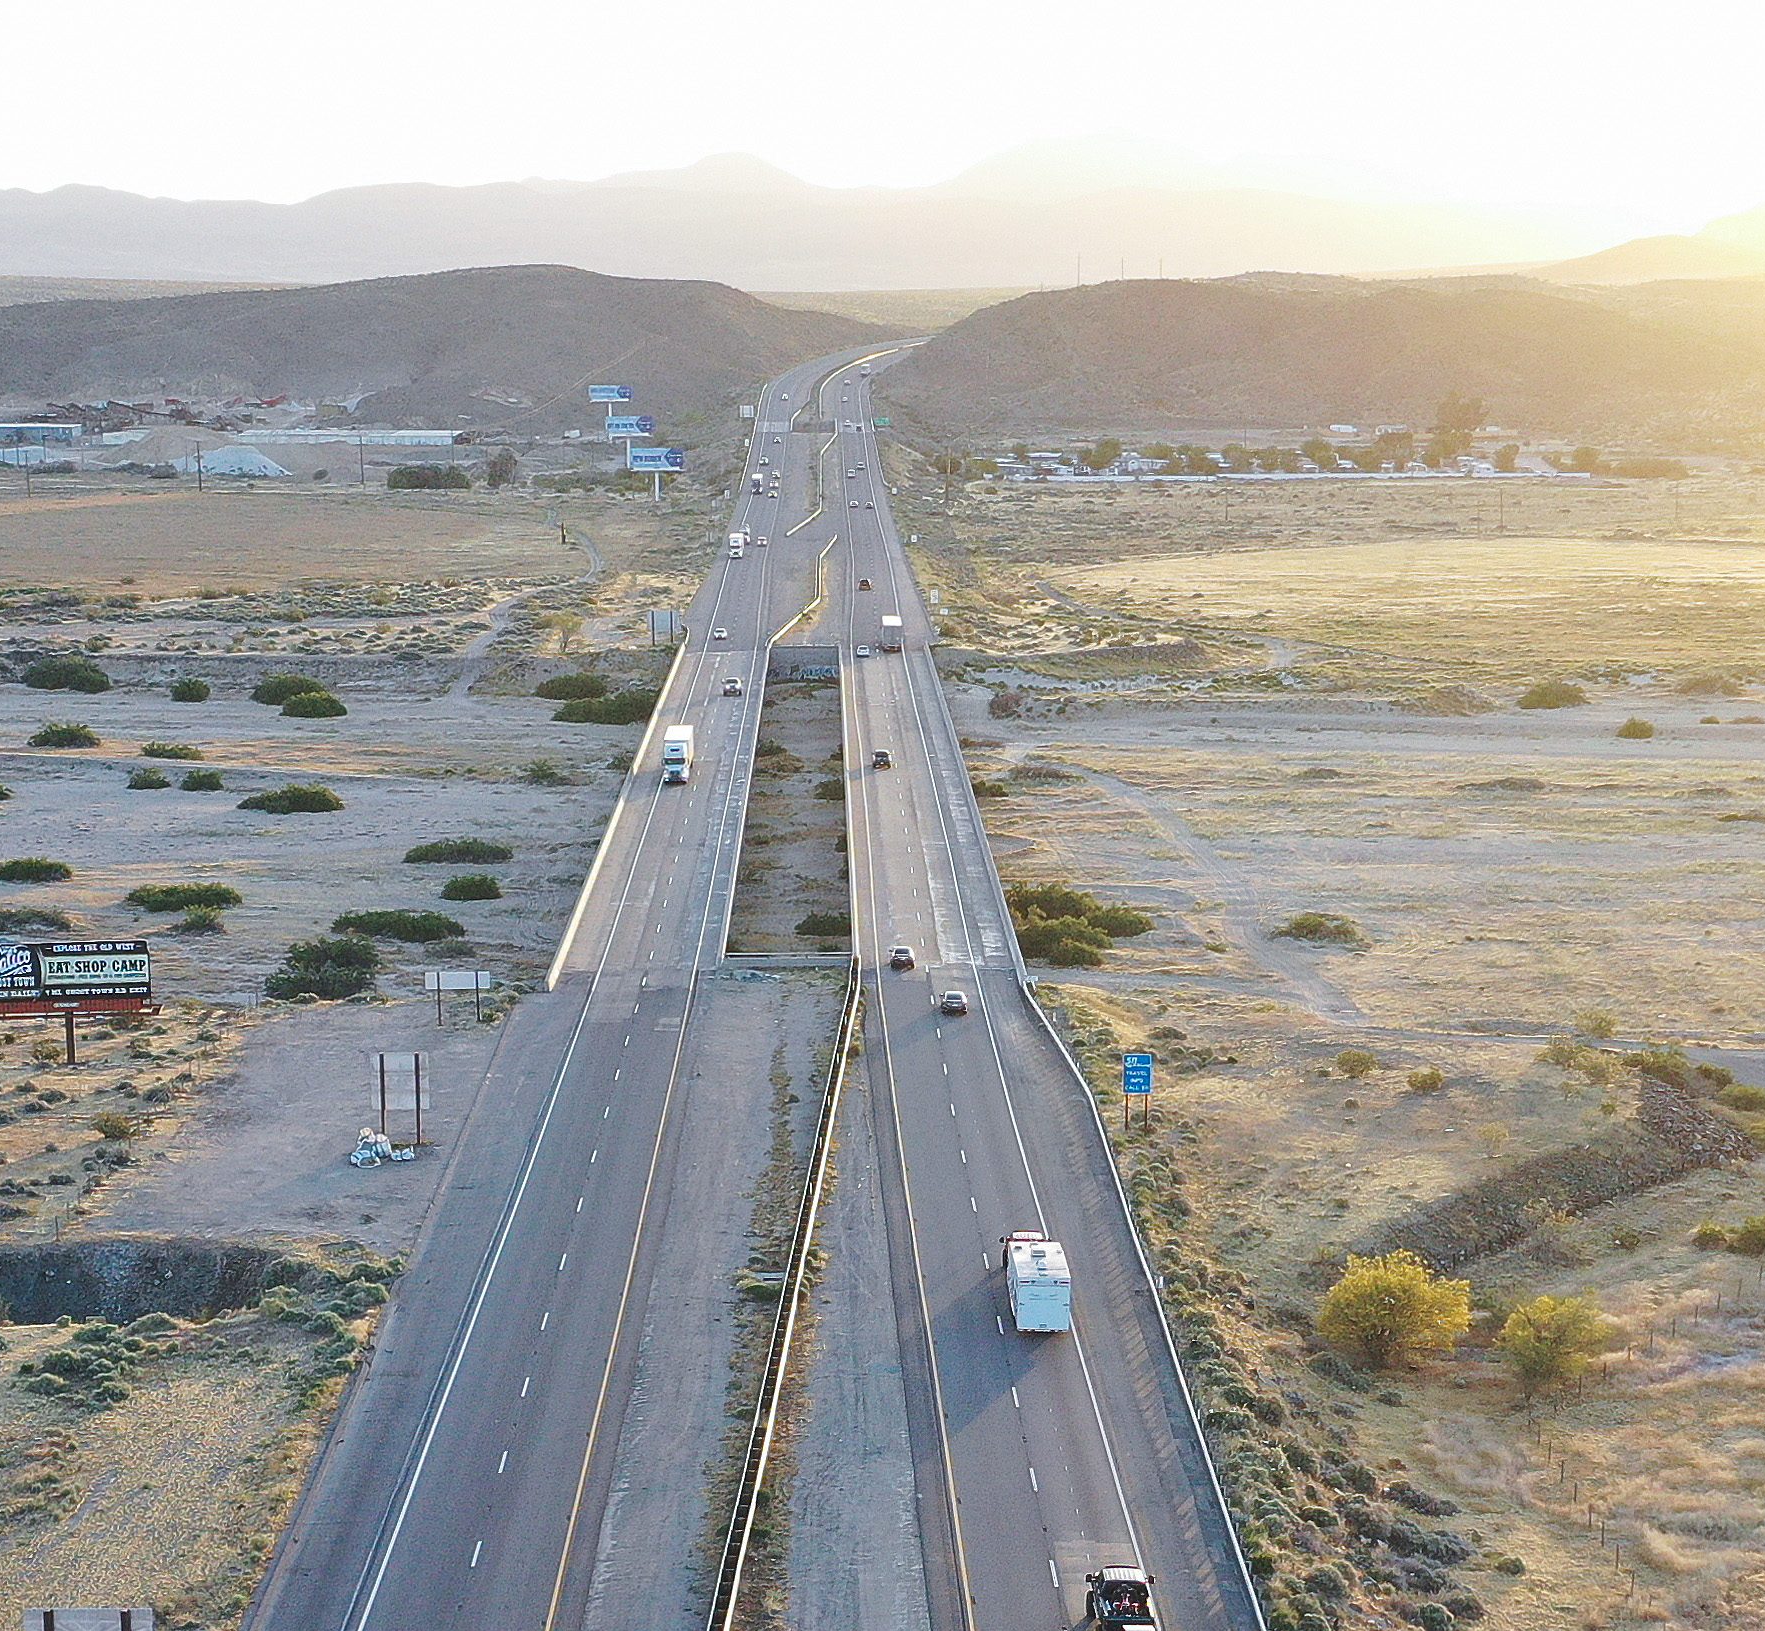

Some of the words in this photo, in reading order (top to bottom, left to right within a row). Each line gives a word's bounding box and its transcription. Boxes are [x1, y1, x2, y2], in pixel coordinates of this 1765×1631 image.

[48, 961, 71, 973] EAT
[75, 960, 107, 973] SHOP
[112, 959, 146, 972] CAMP
